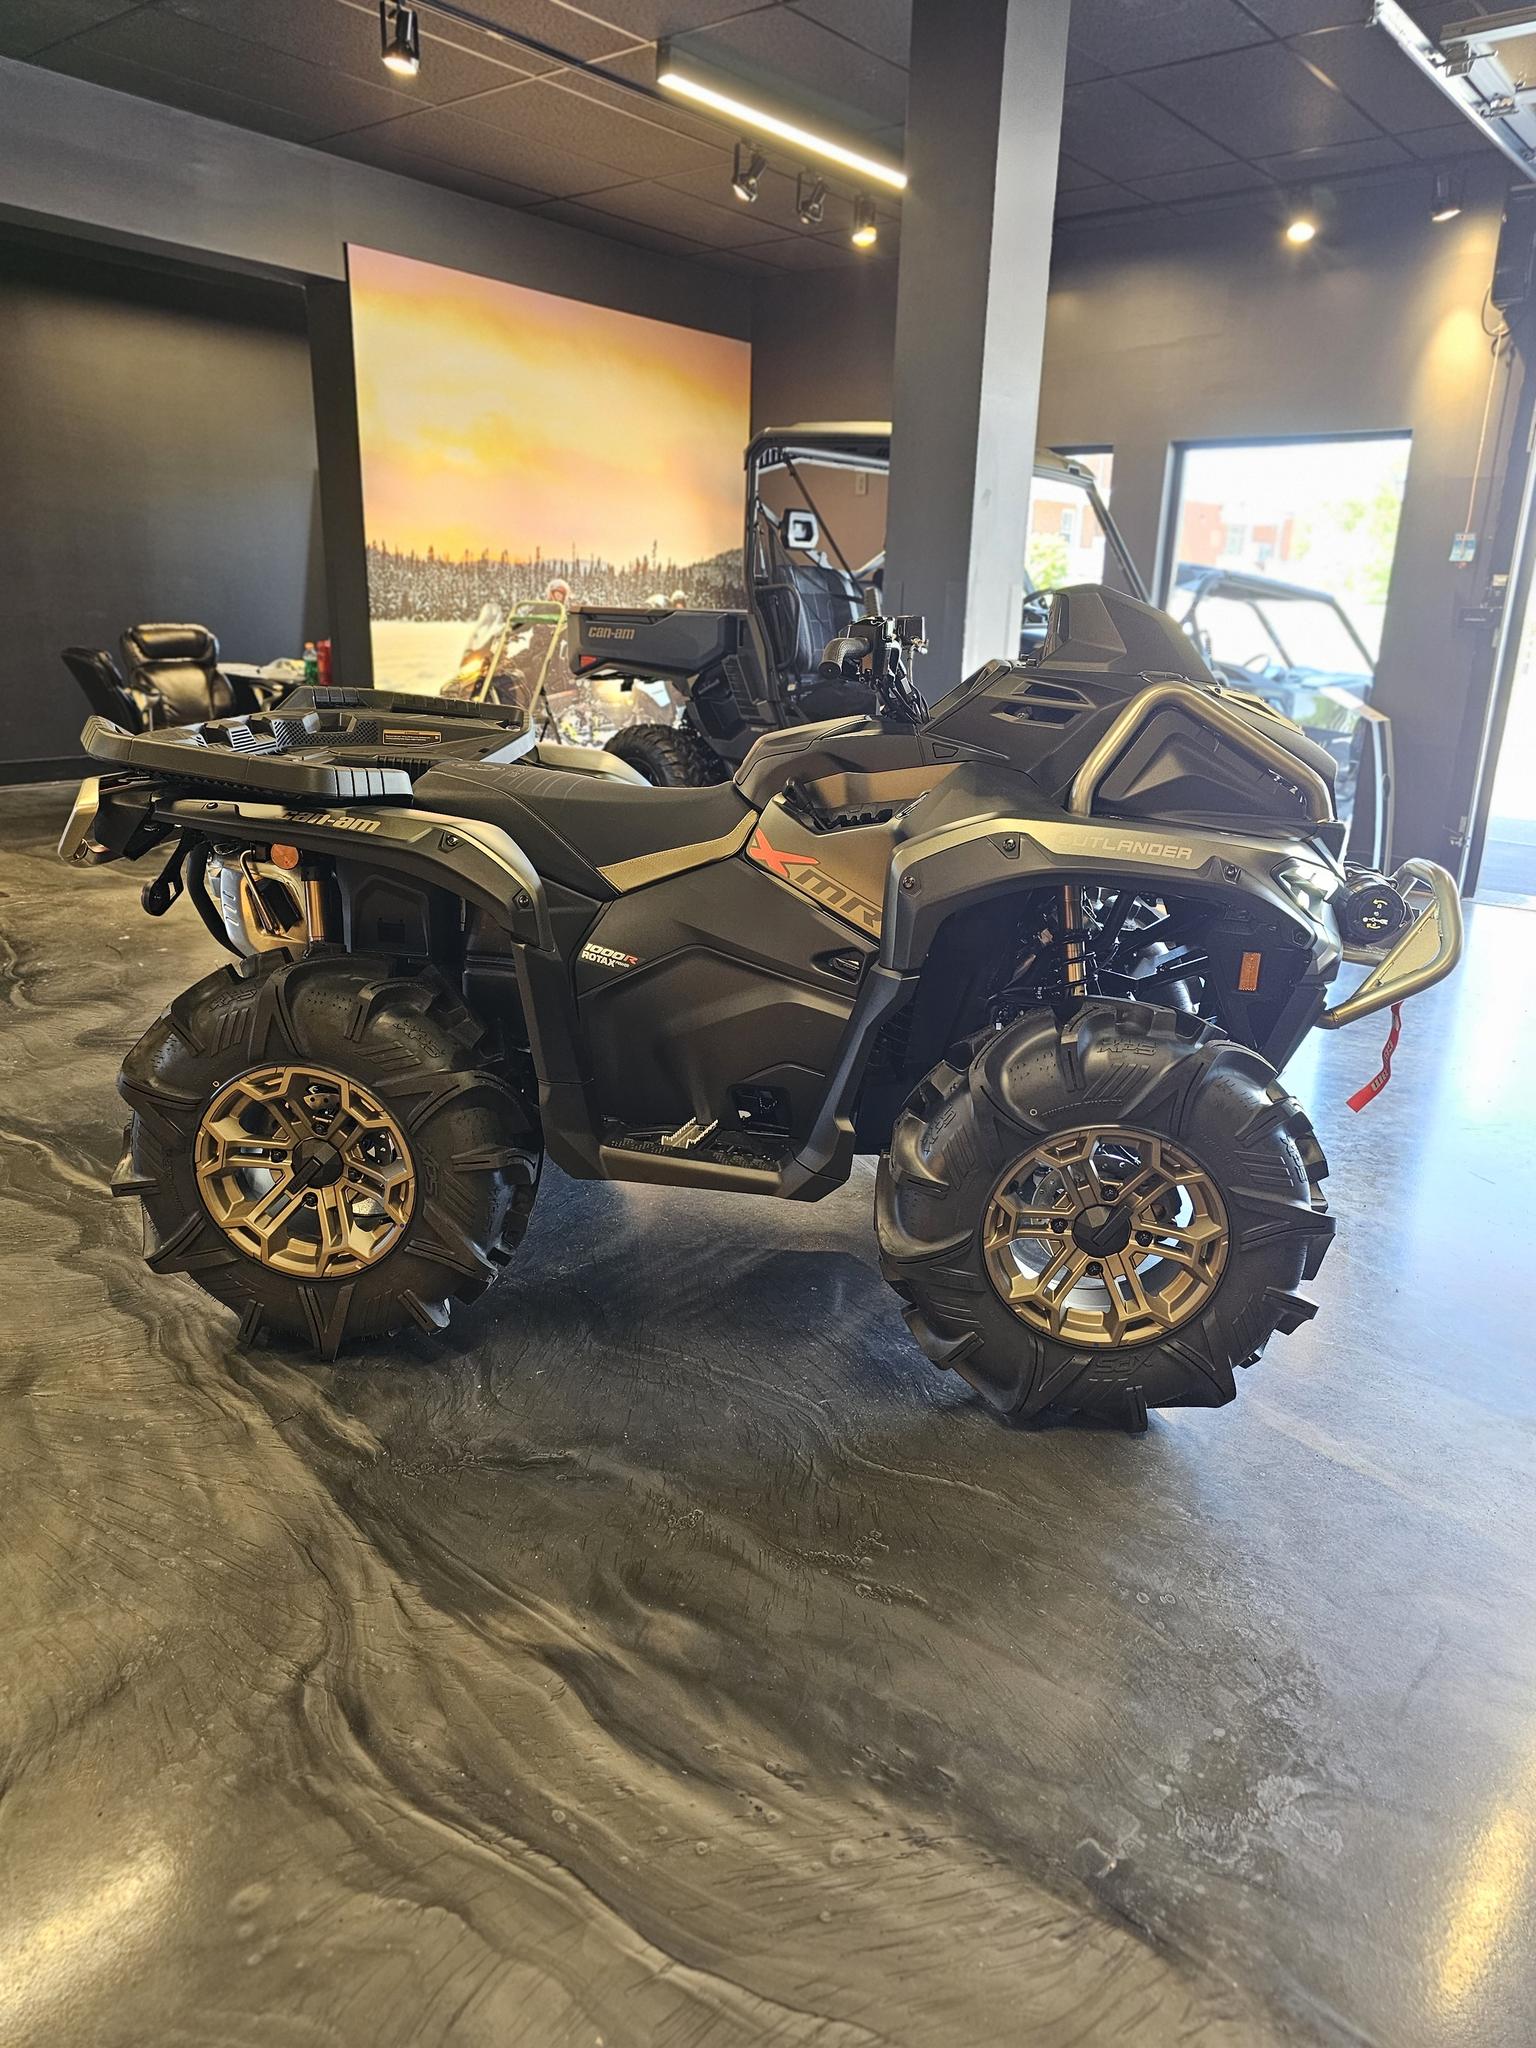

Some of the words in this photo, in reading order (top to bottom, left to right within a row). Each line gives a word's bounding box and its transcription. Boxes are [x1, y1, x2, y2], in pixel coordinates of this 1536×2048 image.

[588, 626, 635, 640] can-am
[281, 810, 381, 833] can-am
[1056, 832, 1193, 860] OUTLANDER
[581, 950, 616, 968] ROTAX
[584, 943, 639, 965] 1000R
